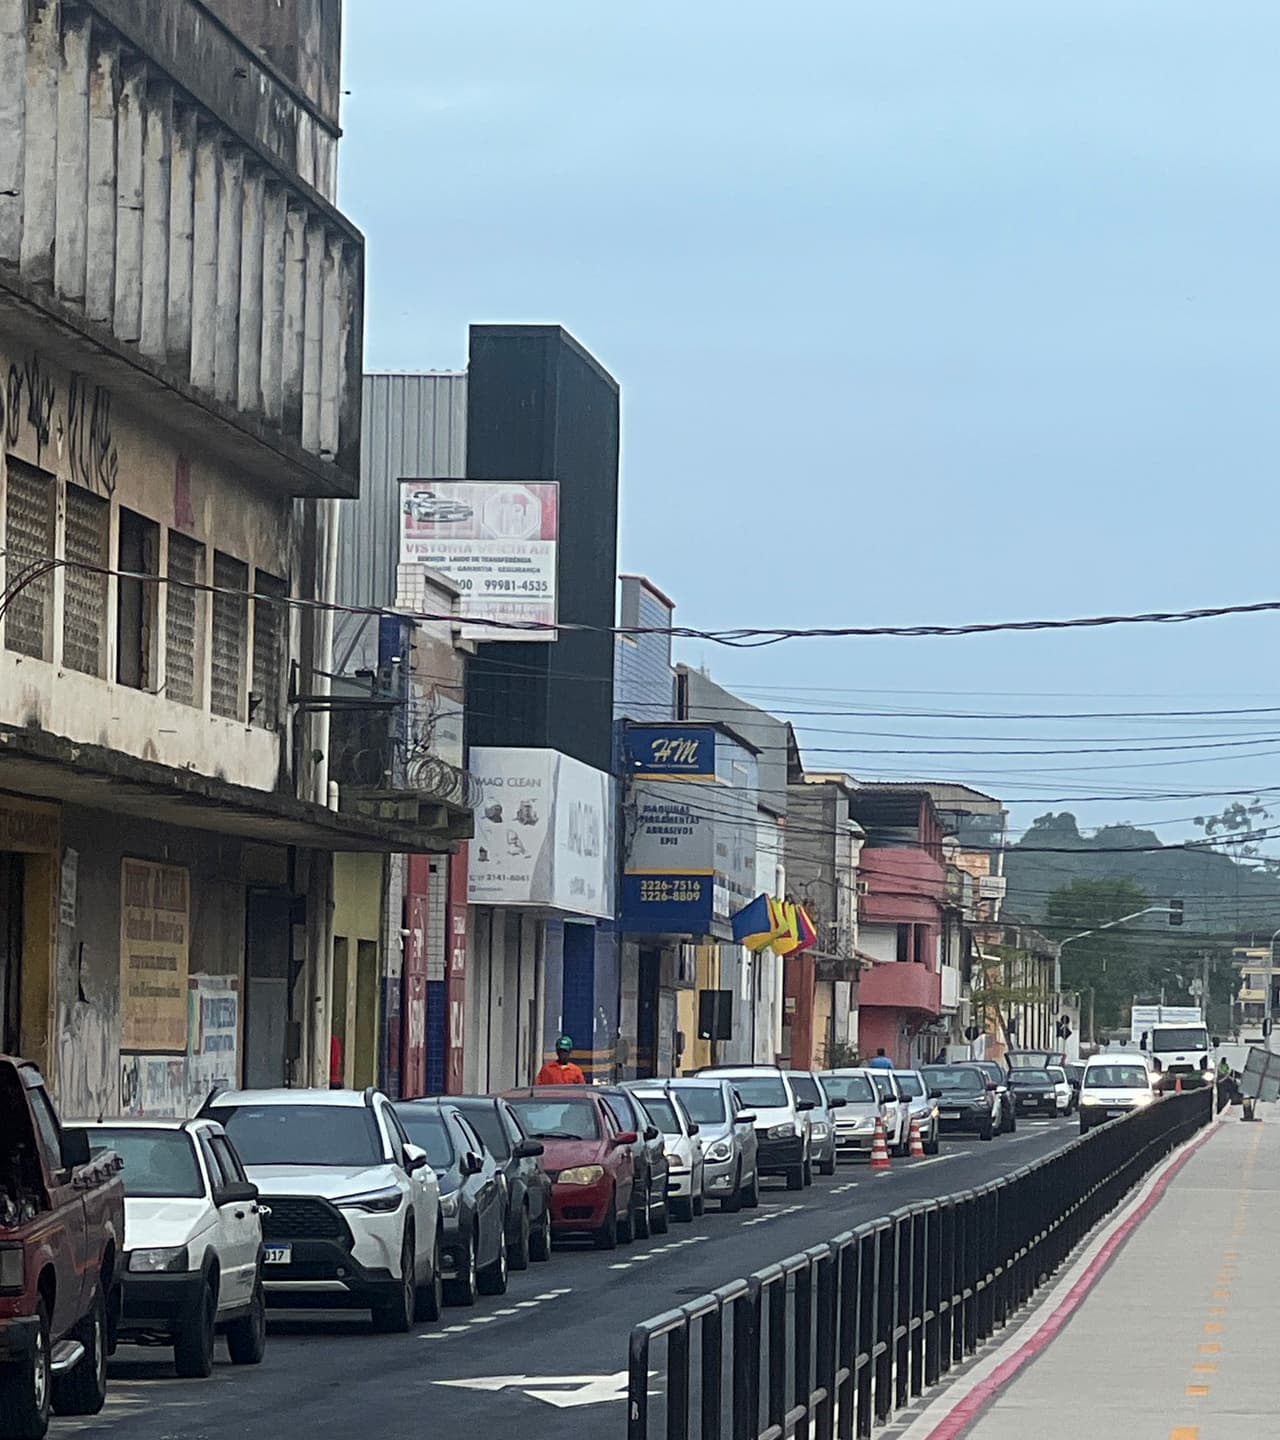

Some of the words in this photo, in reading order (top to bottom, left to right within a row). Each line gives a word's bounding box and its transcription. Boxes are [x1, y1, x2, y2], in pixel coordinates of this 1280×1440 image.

[484, 579, 548, 592] 99981-4535
[507, 777, 542, 788] CLEAN
[640, 880, 701, 890] 3226-7516
[640, 891, 701, 902] 3226-8809
